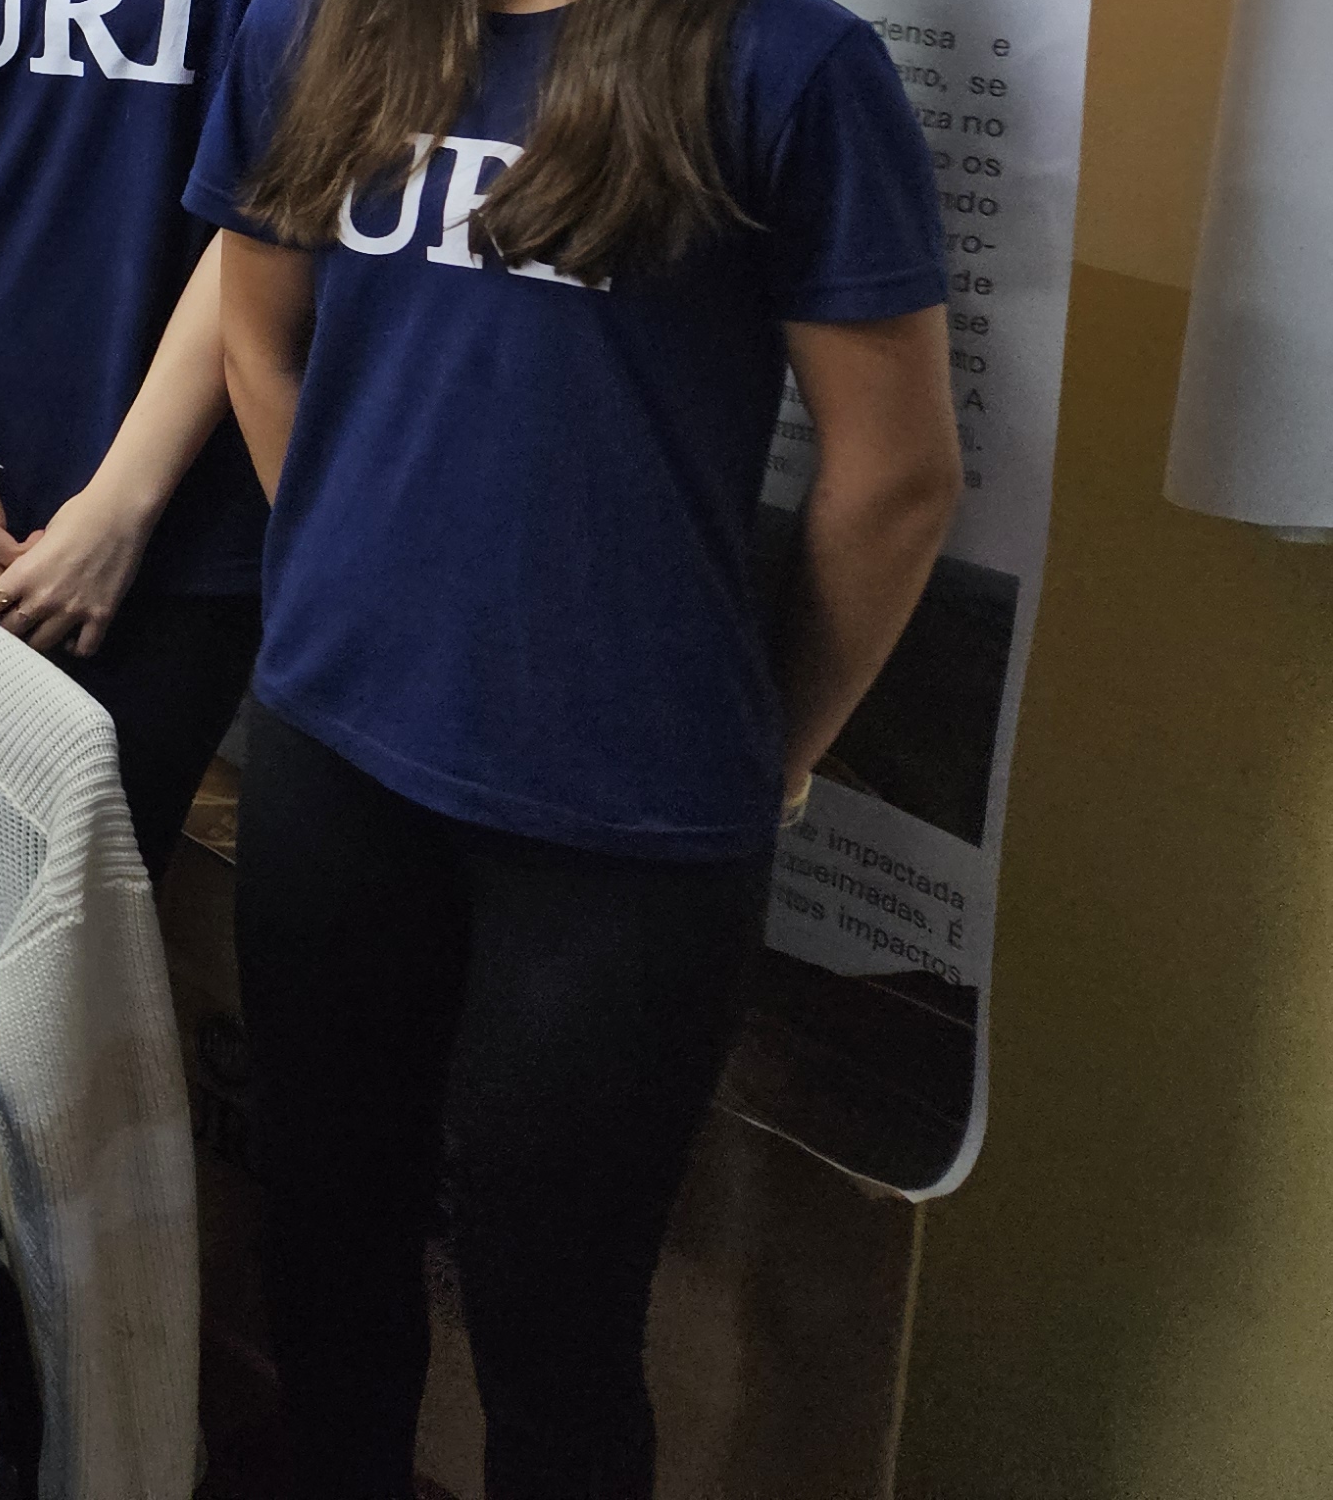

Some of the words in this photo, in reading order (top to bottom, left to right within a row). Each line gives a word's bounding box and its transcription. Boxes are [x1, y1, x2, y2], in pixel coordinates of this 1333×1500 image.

[993, 39, 1010, 57] e
[971, 76, 1008, 97] se
[962, 116, 1004, 137] no
[963, 156, 1003, 178] os
[828, 828, 967, 912] impactada
[838, 903, 962, 986] impactos
